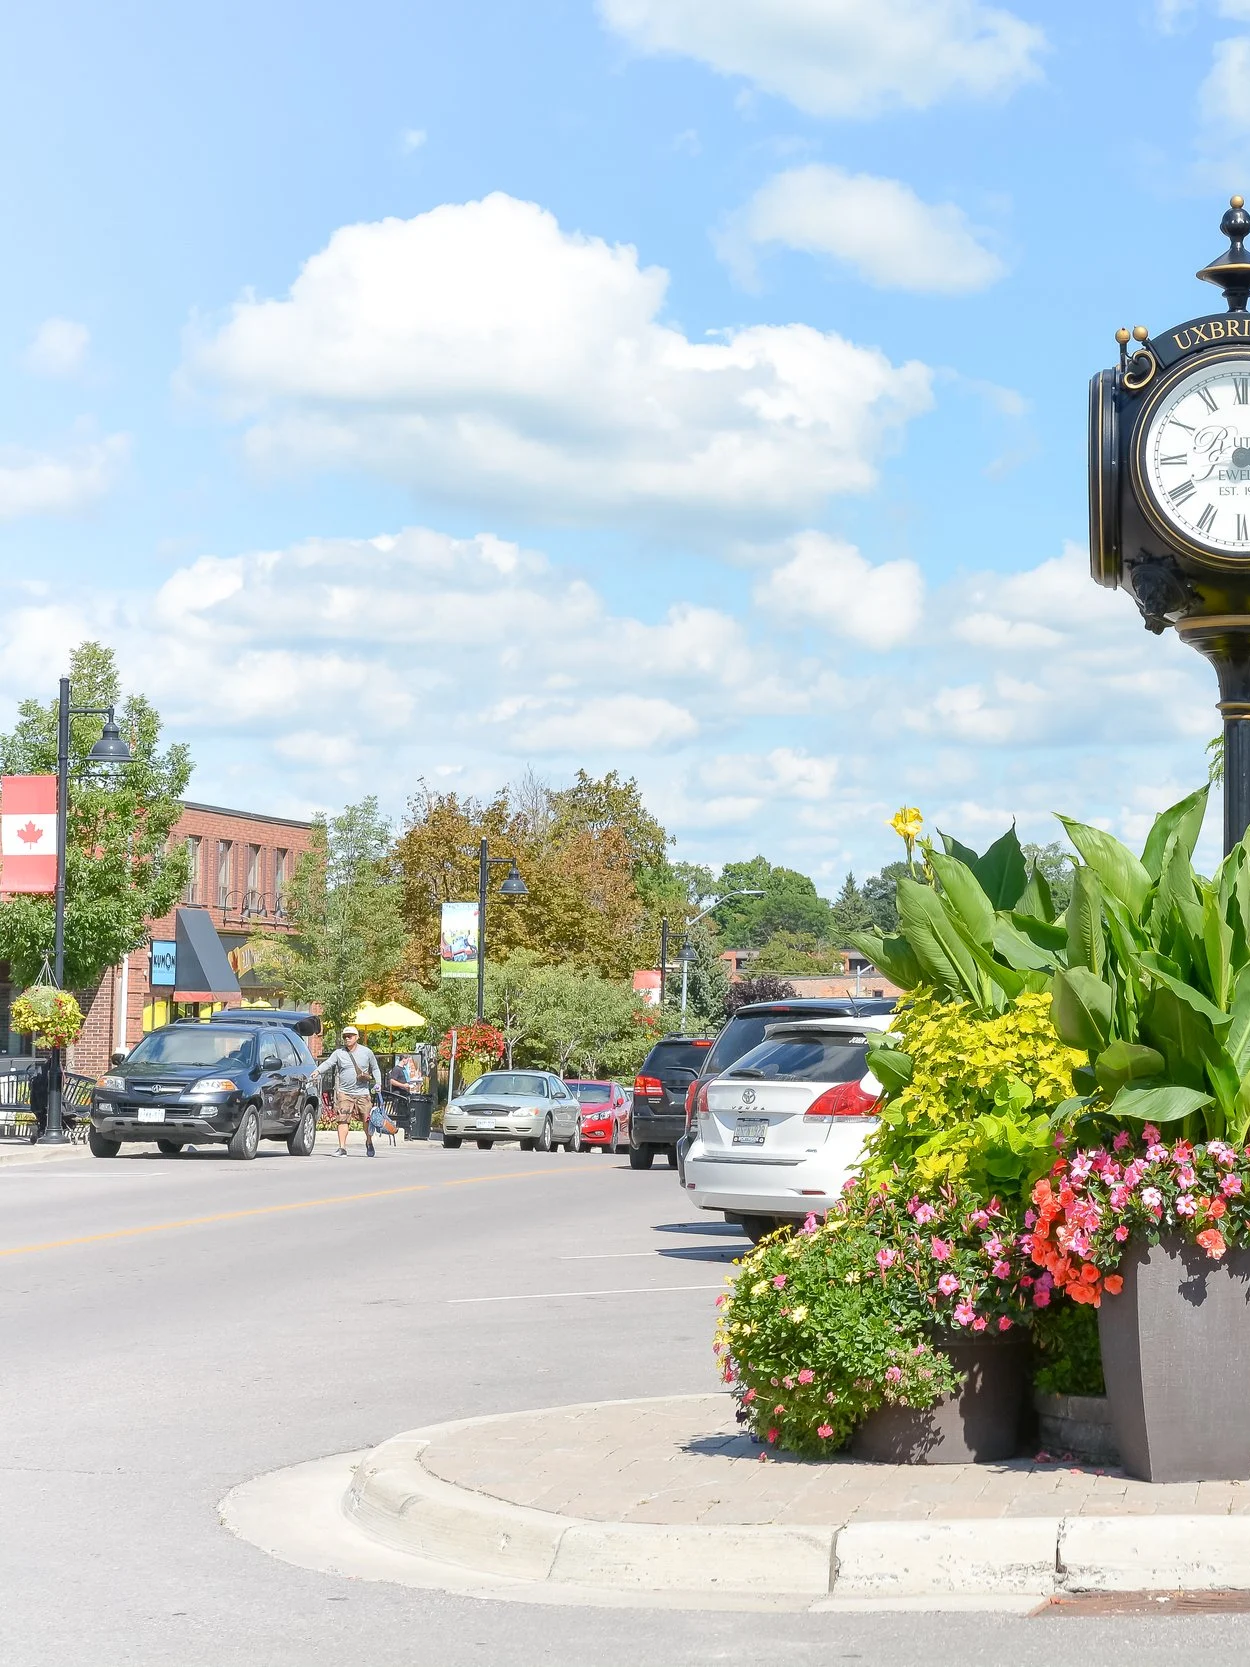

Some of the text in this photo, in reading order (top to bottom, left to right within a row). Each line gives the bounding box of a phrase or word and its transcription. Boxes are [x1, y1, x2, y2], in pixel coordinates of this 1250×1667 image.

[1196, 386, 1219, 415] XI
[1232, 377, 1249, 405] XII
[1169, 415, 1195, 436] X
[1219, 486, 1239, 496] EST.
